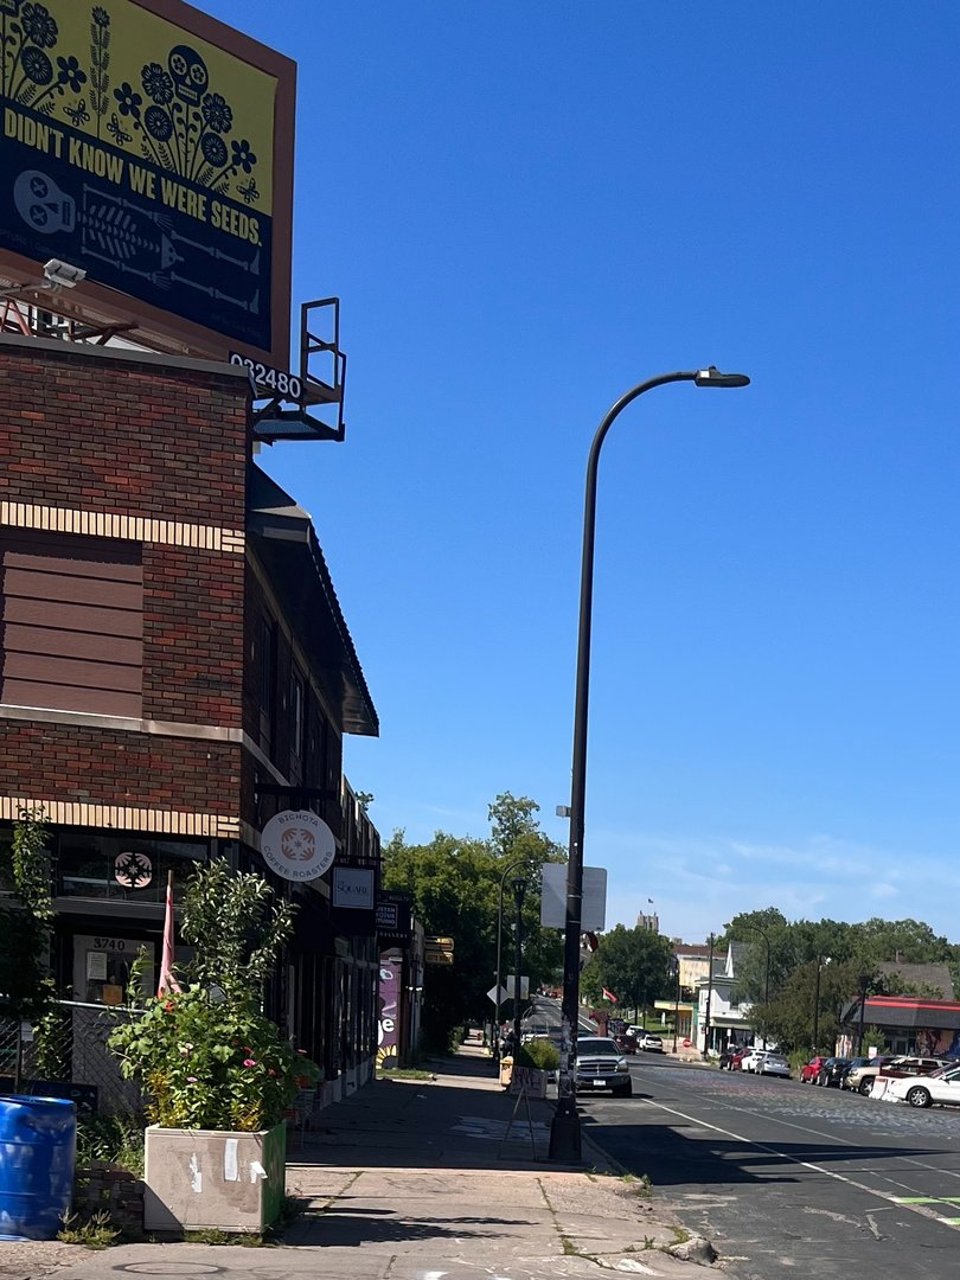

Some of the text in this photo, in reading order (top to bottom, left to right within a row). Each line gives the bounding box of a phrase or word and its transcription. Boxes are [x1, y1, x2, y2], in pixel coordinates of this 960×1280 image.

[4, 107, 262, 247] DIDN'T KNOW WE WERE SEEDS.
[292, 851, 333, 878] ROASTERS
[93, 937, 126, 951] 3740
